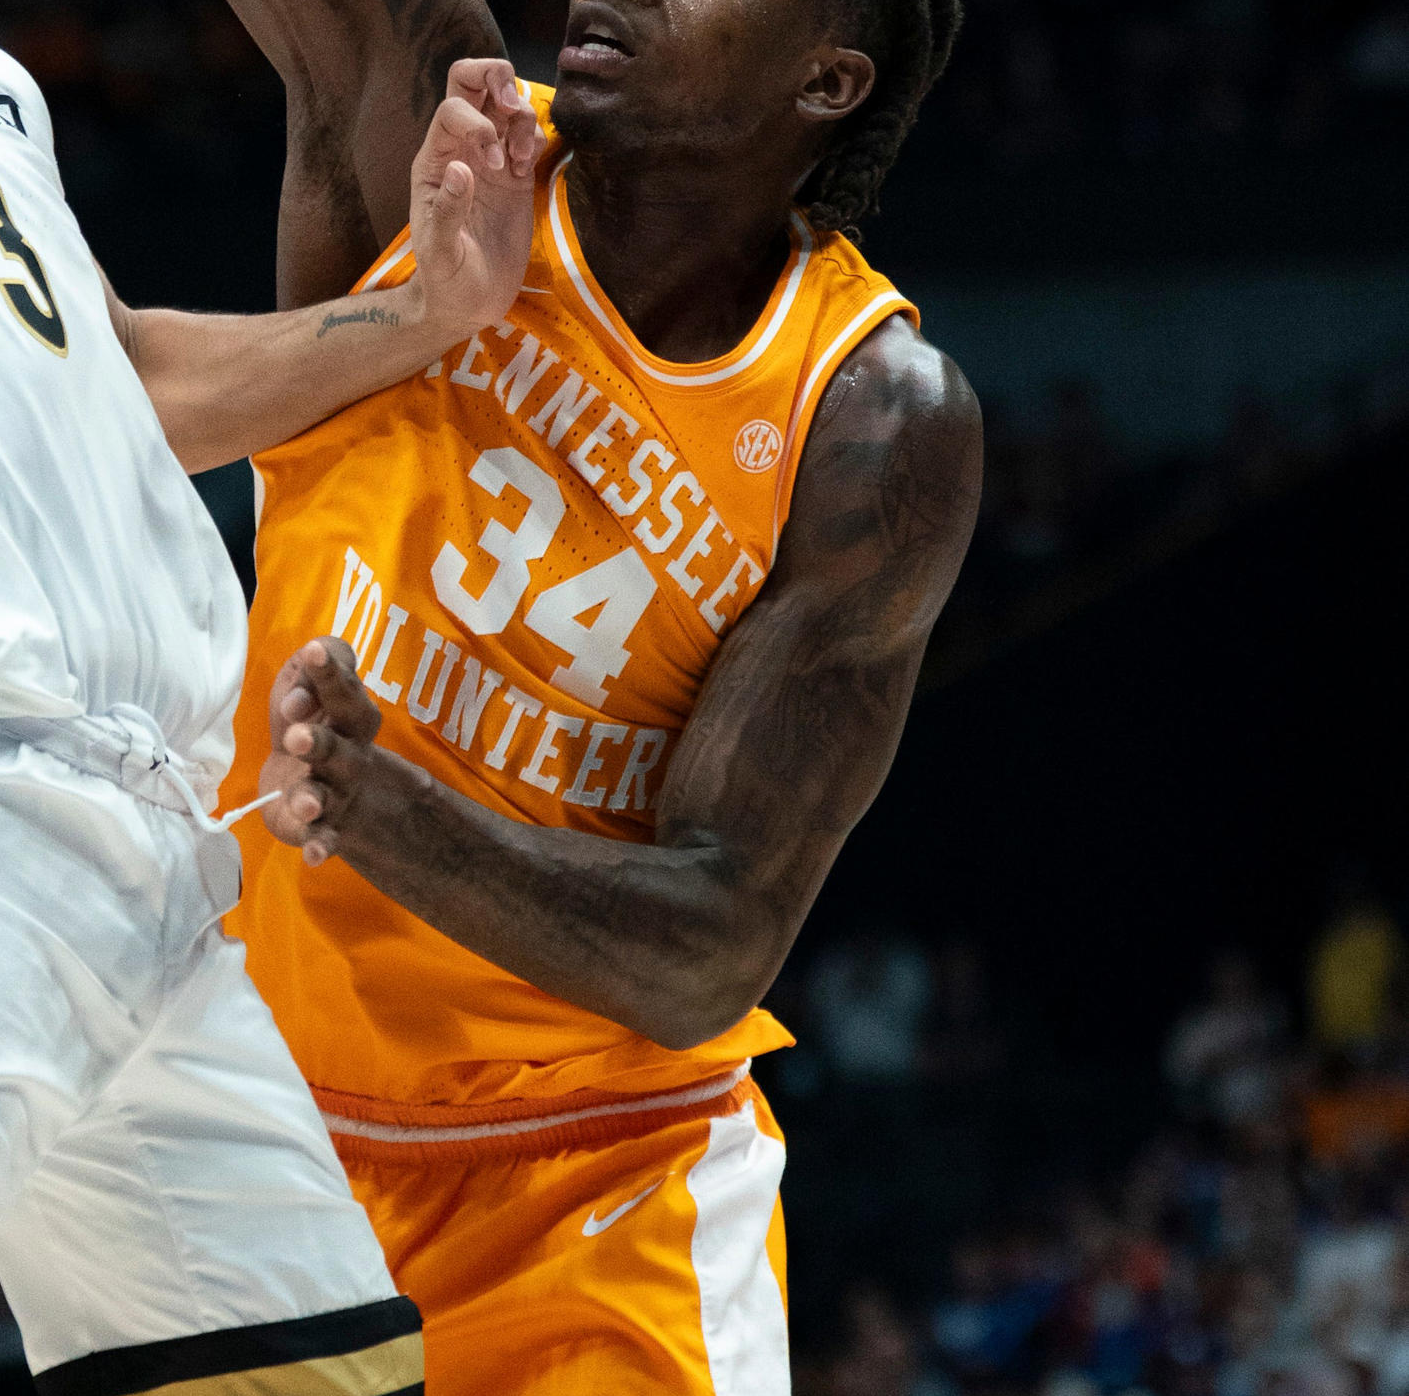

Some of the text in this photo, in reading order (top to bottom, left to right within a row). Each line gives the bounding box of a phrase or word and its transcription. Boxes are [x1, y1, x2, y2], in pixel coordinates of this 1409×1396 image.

[423, 321, 766, 635] ENNESSEE
[430, 446, 658, 711] 34
[737, 423, 780, 468] SEC
[330, 545, 669, 812] VOLUNTEER
